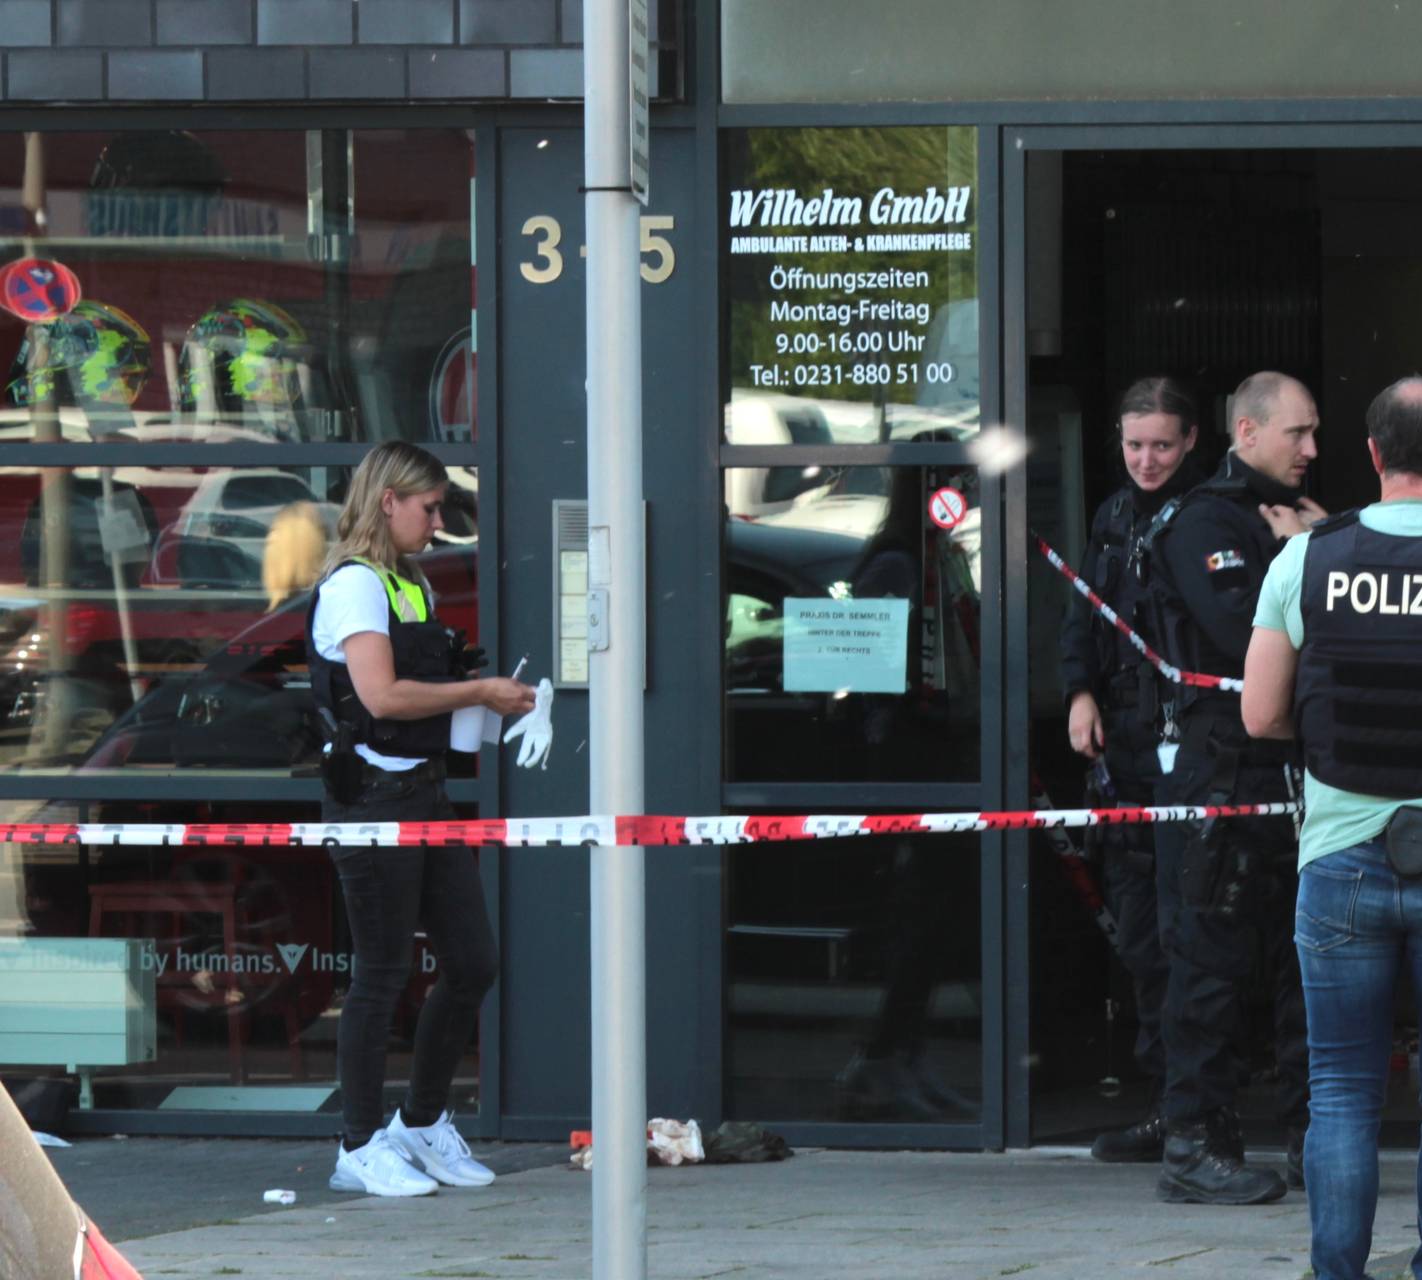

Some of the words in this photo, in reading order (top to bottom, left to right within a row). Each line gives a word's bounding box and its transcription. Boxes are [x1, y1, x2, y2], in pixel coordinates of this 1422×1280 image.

[729, 188, 863, 227] Wilhelm
[869, 186, 971, 226] GmbH
[519, 215, 564, 284] 3
[639, 215, 675, 284] 5
[731, 236, 808, 253] AMBULANTE
[810, 235, 852, 252] ALTEN-
[854, 238, 865, 252] &
[866, 233, 971, 251] KRANKENPFLEGE
[770, 265, 929, 293] Öffnungszeiten
[770, 299, 930, 326] Montag-Freitag
[775, 332, 883, 354] 9.00-16.00
[888, 330, 926, 352] Uhr
[750, 365, 789, 386] Tel.:
[794, 363, 891, 386] 0231-880
[897, 363, 918, 384] 51
[926, 362, 952, 384] 00
[141, 943, 168, 977] by
[176, 946, 282, 974] humans.
[312, 947, 357, 977] Ins
[422, 946, 437, 973] b
